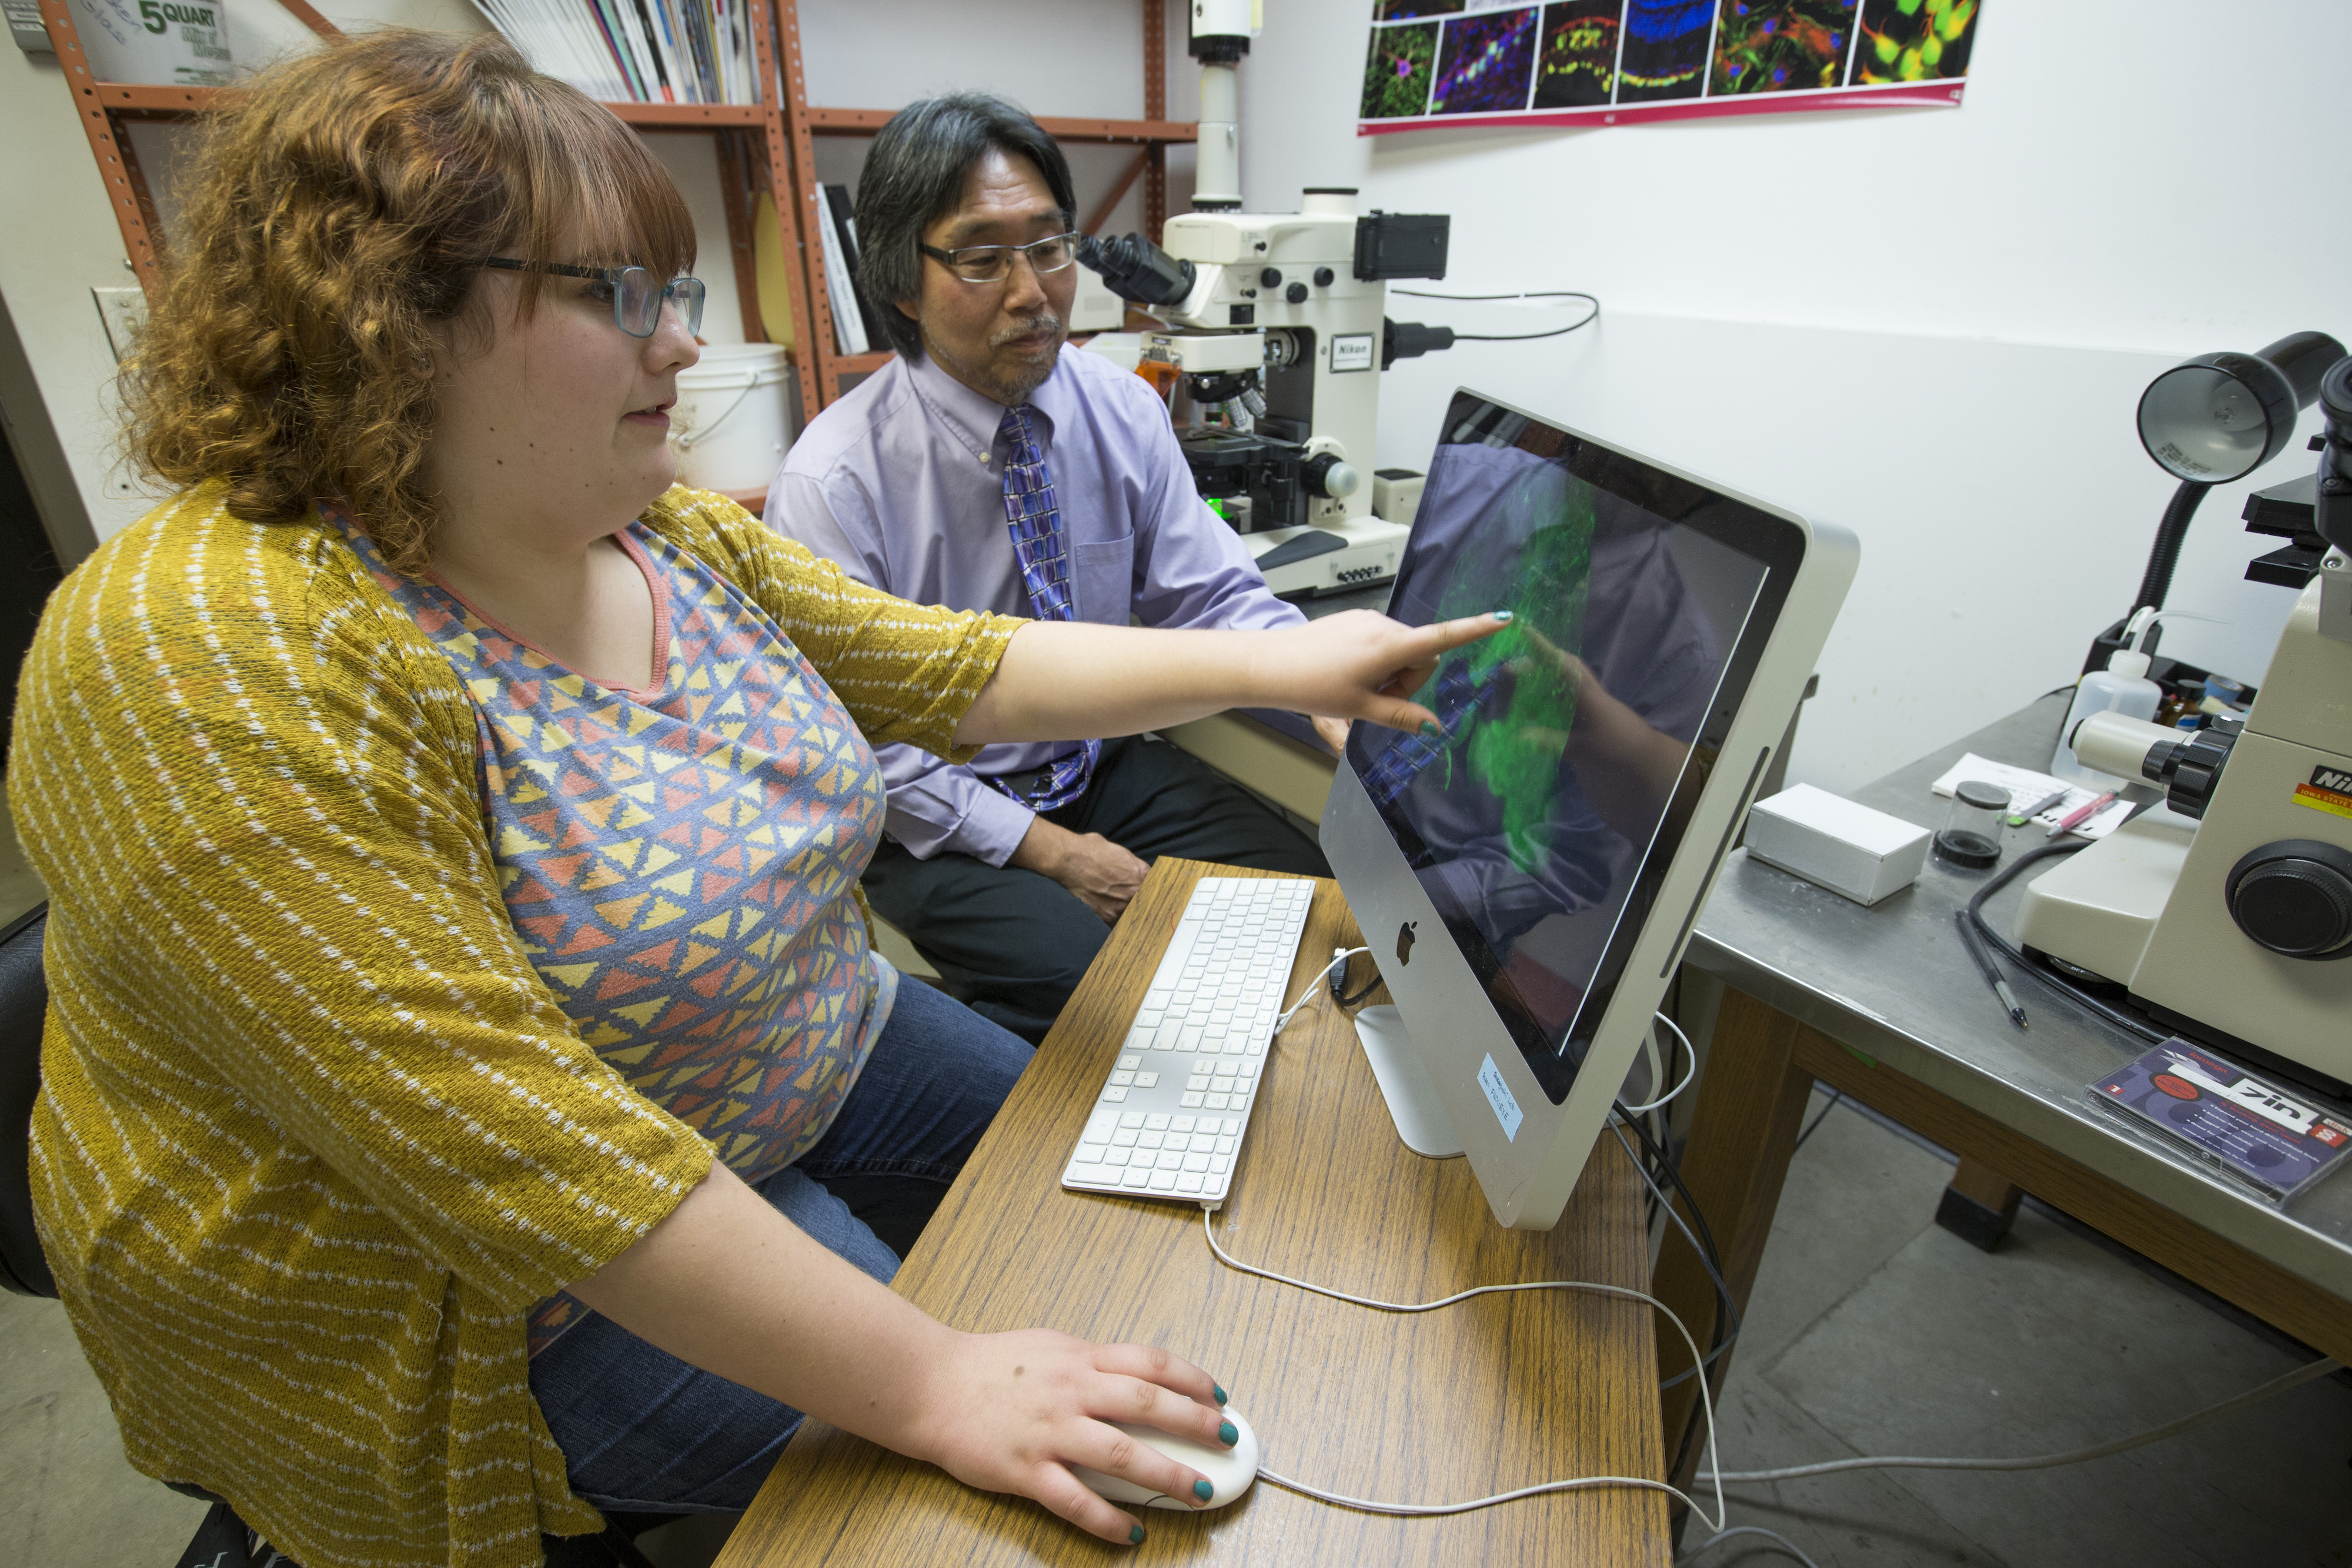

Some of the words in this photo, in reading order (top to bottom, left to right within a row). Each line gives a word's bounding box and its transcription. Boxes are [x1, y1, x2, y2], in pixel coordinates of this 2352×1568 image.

[139, 0, 167, 35] 5
[162, 3, 216, 28] QUART
[1339, 345, 1367, 354] Nikon
[2301, 789, 2321, 799] IOWA
[2323, 795, 2348, 807] STATE
[2190, 1121, 2206, 1131] Great
[2216, 1135, 2247, 1154] multimedia
[2198, 1116, 2220, 1129] Rugged
[2231, 1134, 2254, 1146] reliable
[2206, 1111, 2227, 1124] Backup
[2240, 1129, 2254, 1138] easy
[2213, 1106, 2235, 1118] Expand
[2235, 1117, 2249, 1125] your
[2249, 1124, 2264, 1133] hard
[2264, 1132, 2280, 1141] drive
[2280, 1140, 2303, 1154] without
[2303, 1152, 2321, 1163] limits
[2316, 1128, 2337, 1142] 100
[2327, 1119, 2350, 1134] disk
